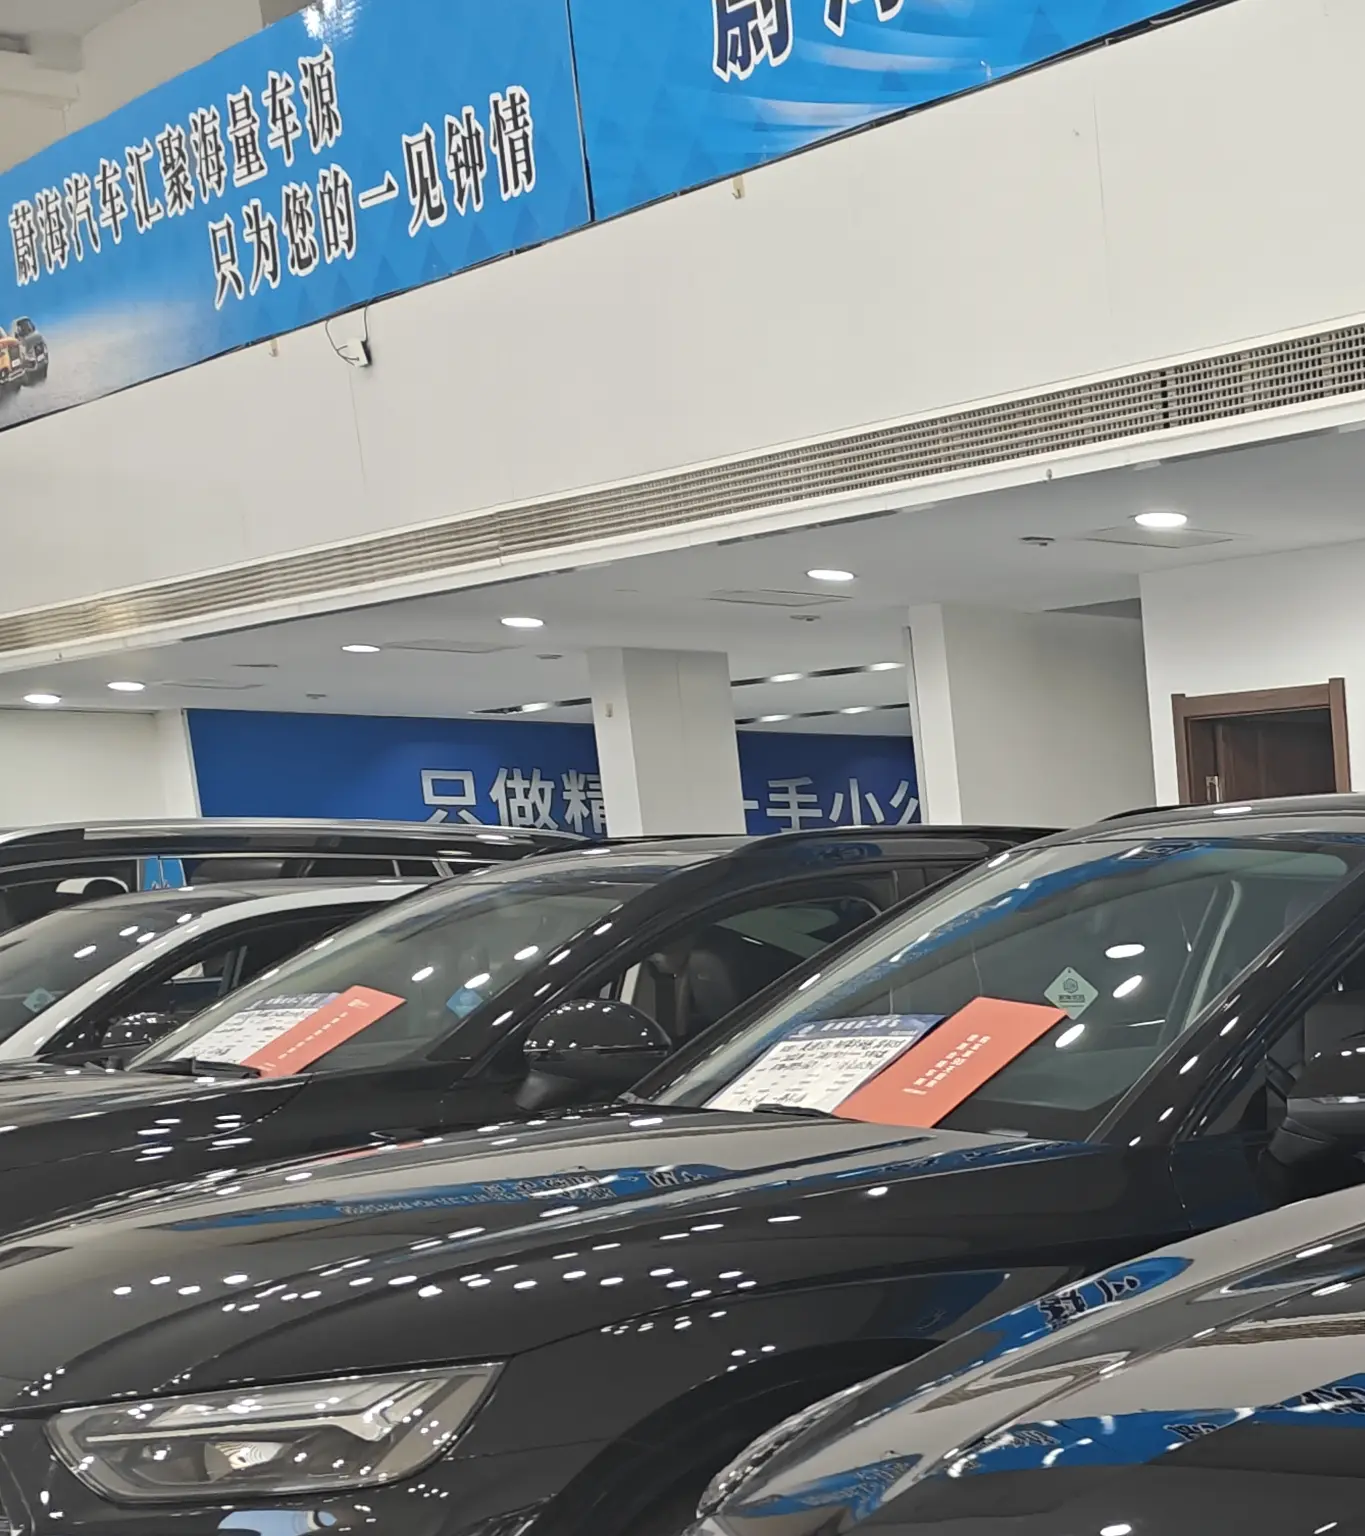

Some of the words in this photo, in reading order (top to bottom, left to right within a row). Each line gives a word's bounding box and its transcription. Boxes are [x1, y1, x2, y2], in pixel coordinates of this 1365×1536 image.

[8, 45, 342, 286] 蔚海汽车汇聚海量车源
[208, 86, 535, 309] 只为您的一见钟情
